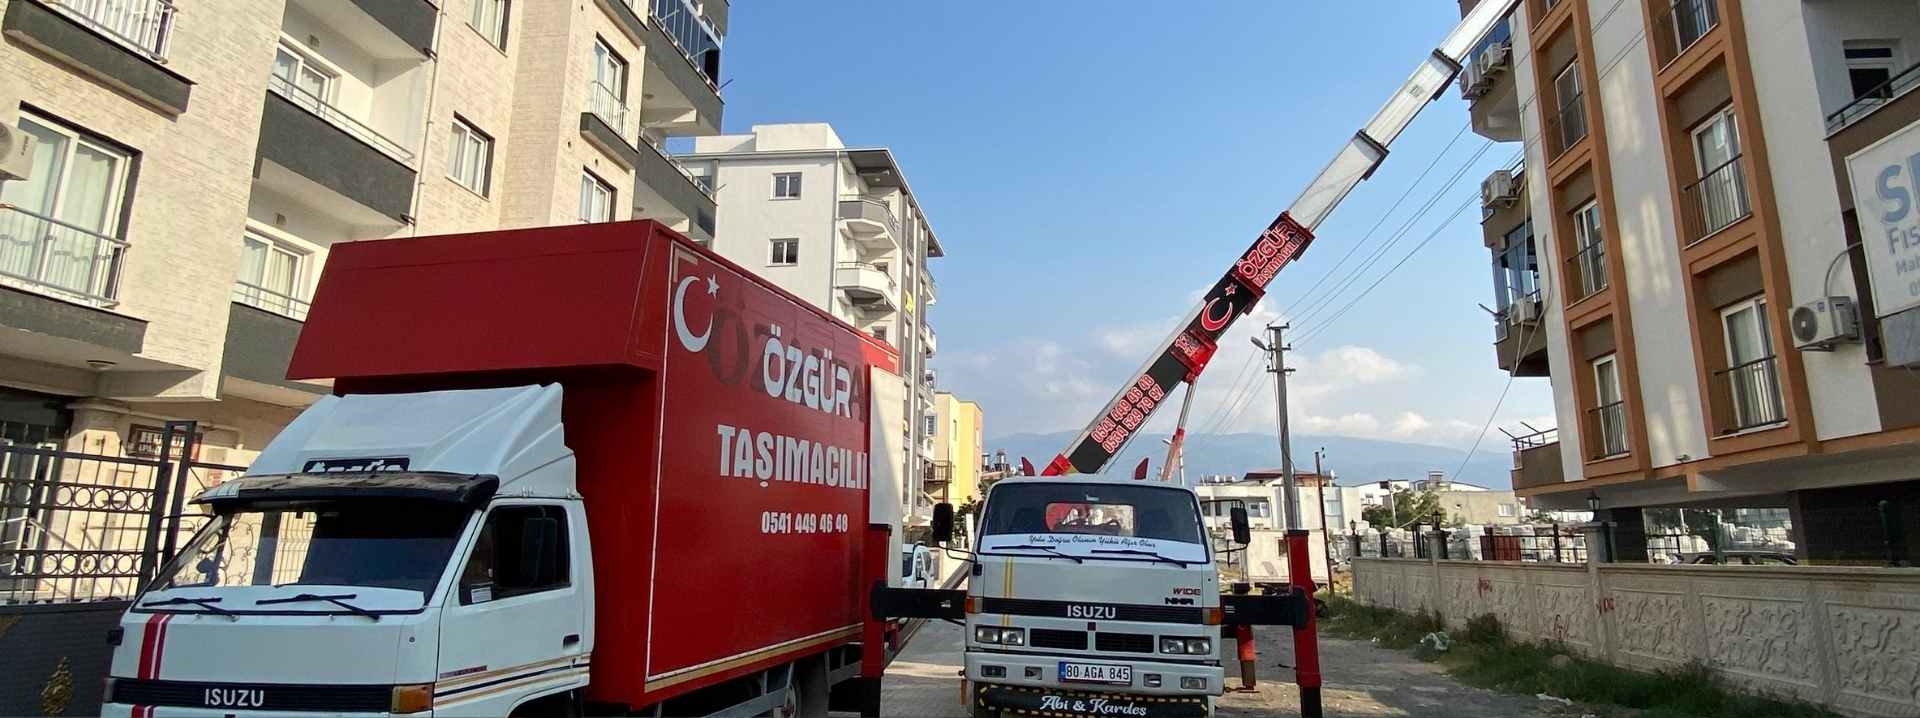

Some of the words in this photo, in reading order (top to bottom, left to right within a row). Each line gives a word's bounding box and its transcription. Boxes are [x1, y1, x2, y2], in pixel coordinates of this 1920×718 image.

[1237, 221, 1298, 280] ÖZGÜR
[763, 323, 851, 418] ÖZGÜR
[1090, 416, 1117, 443] 0541
[1110, 398, 1133, 422] 449
[1126, 386, 1144, 404] 46
[1137, 374, 1155, 392] 48
[1101, 425, 1129, 453] 0534
[1122, 407, 1144, 430] 529
[1136, 396, 1155, 414] 79
[1147, 383, 1165, 401] 97
[762, 511, 791, 534] 0541
[795, 513, 817, 534] 449
[820, 513, 833, 533] 46
[835, 513, 848, 533] 48
[1173, 587, 1200, 596] WIDE
[1067, 604, 1116, 619] ISUZU
[1066, 665, 1079, 678] 80
[1084, 666, 1104, 680] AGA
[1109, 667, 1129, 681] 845
[204, 688, 264, 707] ISUZU
[1040, 695, 1068, 710] Abi
[1072, 700, 1086, 712] &
